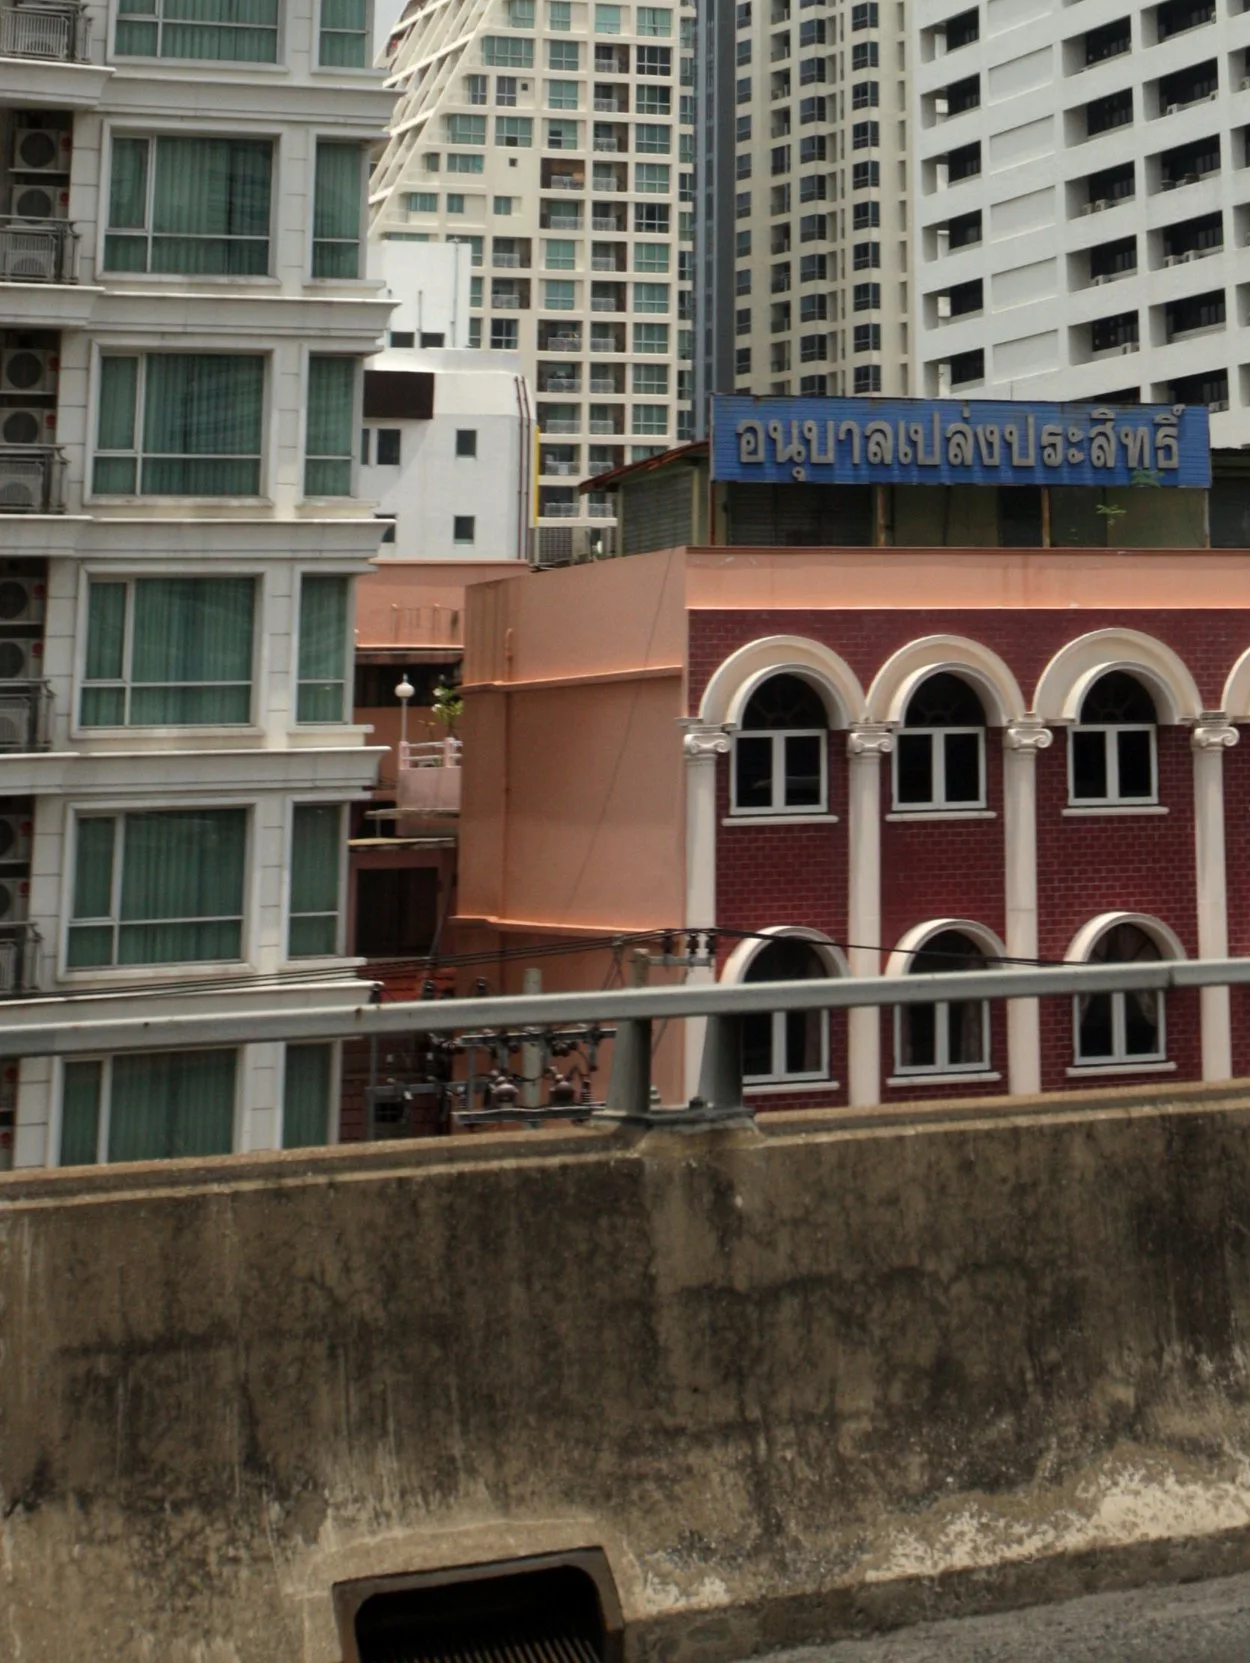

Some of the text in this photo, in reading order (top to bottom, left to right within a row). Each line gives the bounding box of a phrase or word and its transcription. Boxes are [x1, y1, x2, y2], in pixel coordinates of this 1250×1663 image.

[736, 401, 1186, 482] อนุบาลเปล่งประสิทธิ์
